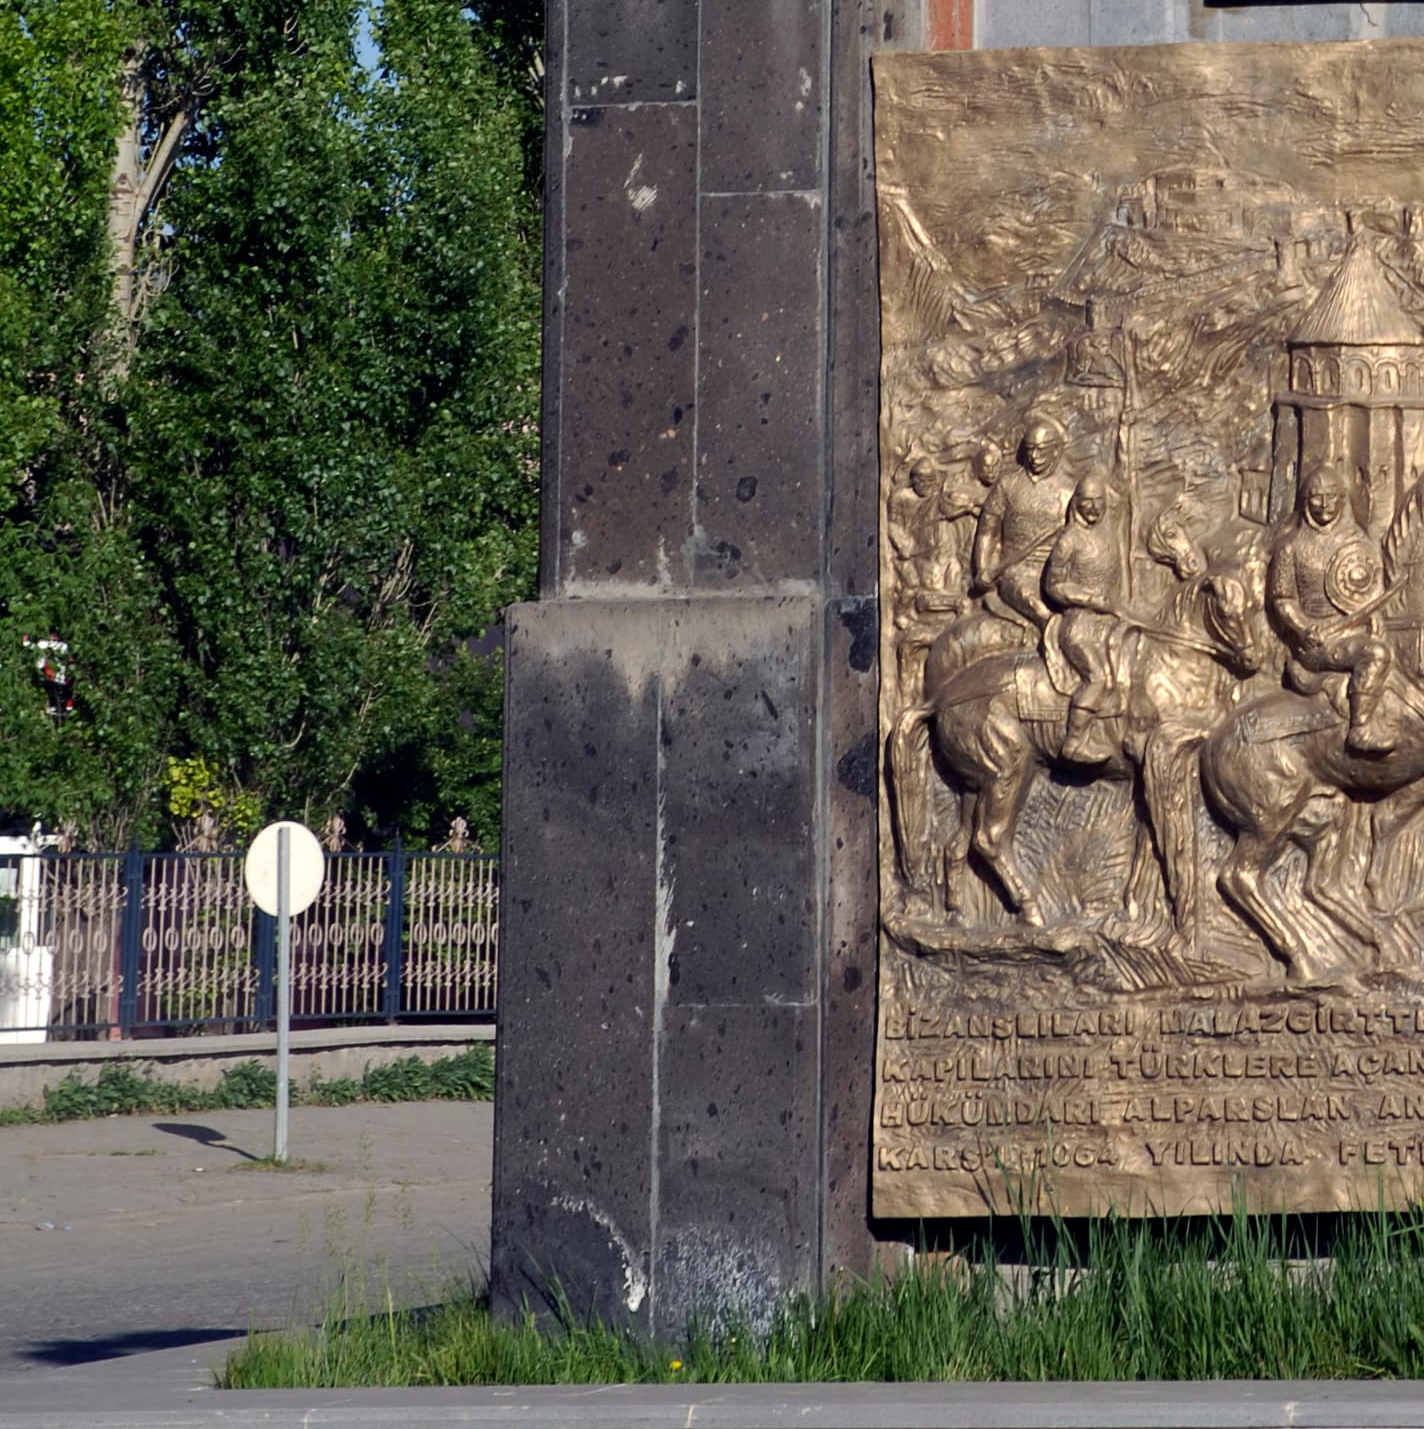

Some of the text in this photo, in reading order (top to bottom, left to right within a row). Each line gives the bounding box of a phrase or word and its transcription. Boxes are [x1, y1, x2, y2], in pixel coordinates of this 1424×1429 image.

[885, 1006, 1134, 1039] BİZANSLILARI
[882, 1052, 1094, 1082] KAPILARINI
[1110, 1043, 1317, 1079] TÜRKLERE
[880, 1091, 1099, 1128] HÜKÜMDARI
[1123, 1095, 1349, 1122] ALPARSLAN
[1145, 1139, 1303, 1167] YILINDA
